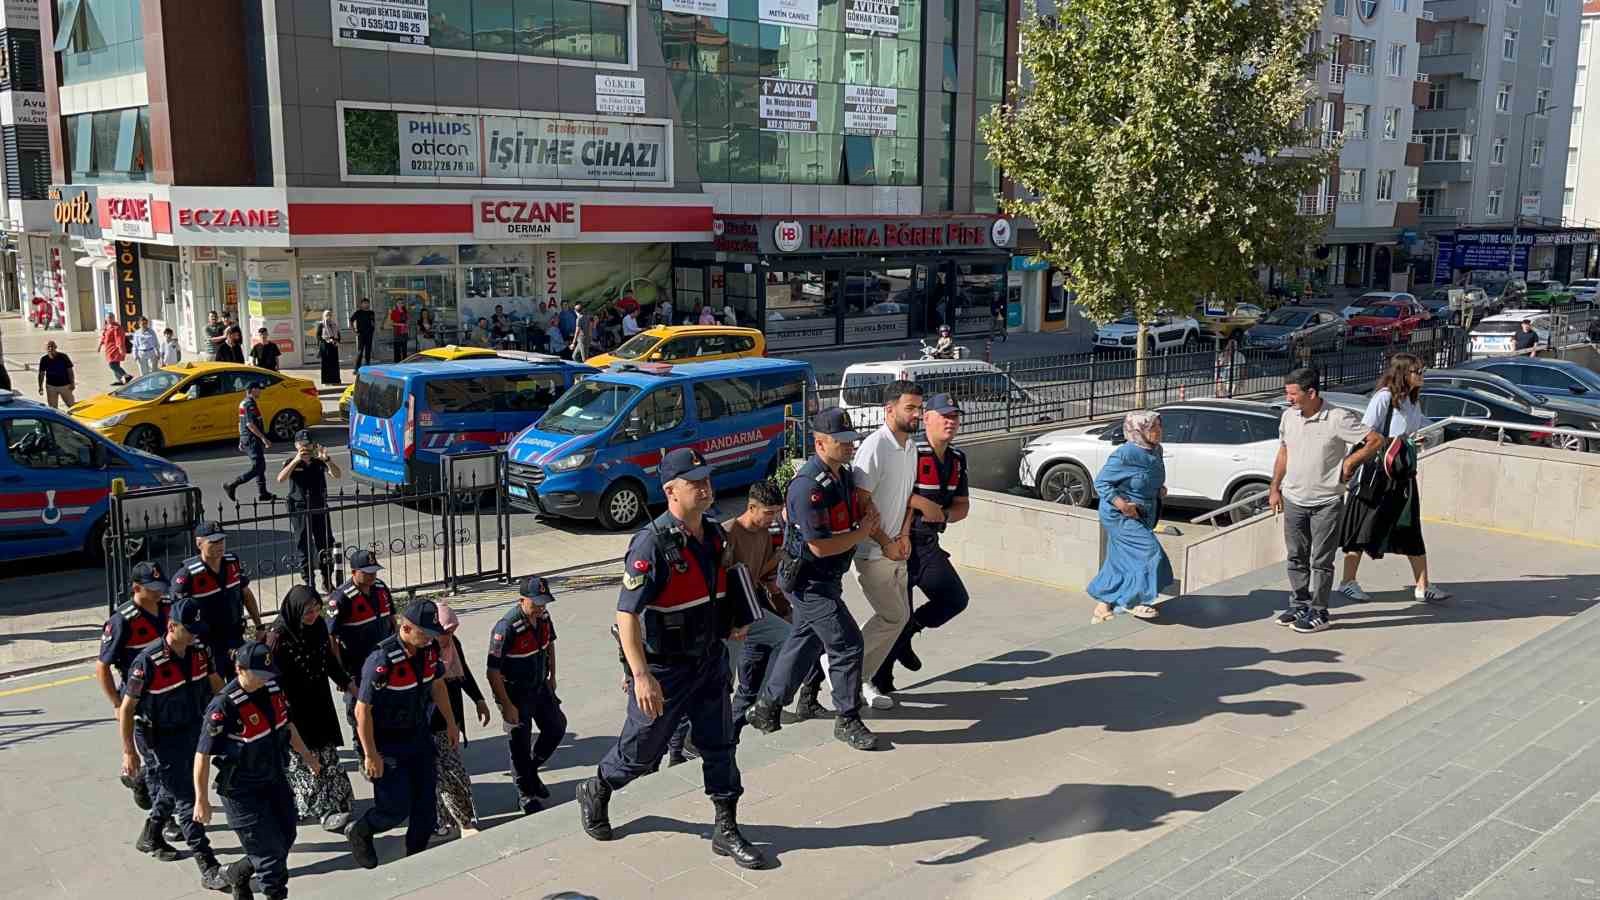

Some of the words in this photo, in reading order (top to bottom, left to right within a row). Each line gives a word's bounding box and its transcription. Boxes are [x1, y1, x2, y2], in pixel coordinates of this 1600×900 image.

[852, 0, 891, 15] AVUKAT
[368, 18, 383, 30] 535
[847, 11, 872, 23] GÖKHAN
[873, 15, 897, 26] TURHAN
[773, 81, 814, 97] AVUKAT
[23, 98, 46, 108] Avu
[856, 104, 886, 114] AVUKAT
[409, 120, 472, 136] PHILIPS
[411, 139, 470, 156] oticon
[488, 129, 577, 169] İŞİTME
[581, 139, 660, 168] CİHAZI
[54, 188, 91, 232] optik
[178, 207, 281, 228] ECZANE
[480, 201, 575, 223] ECZANE
[507, 224, 551, 234] DERMAN
[782, 228, 797, 241] HB
[884, 223, 944, 247] BÖREK
[947, 223, 987, 247] PİDE
[545, 251, 558, 310] ECZA
[704, 428, 764, 452] JANDARMA
